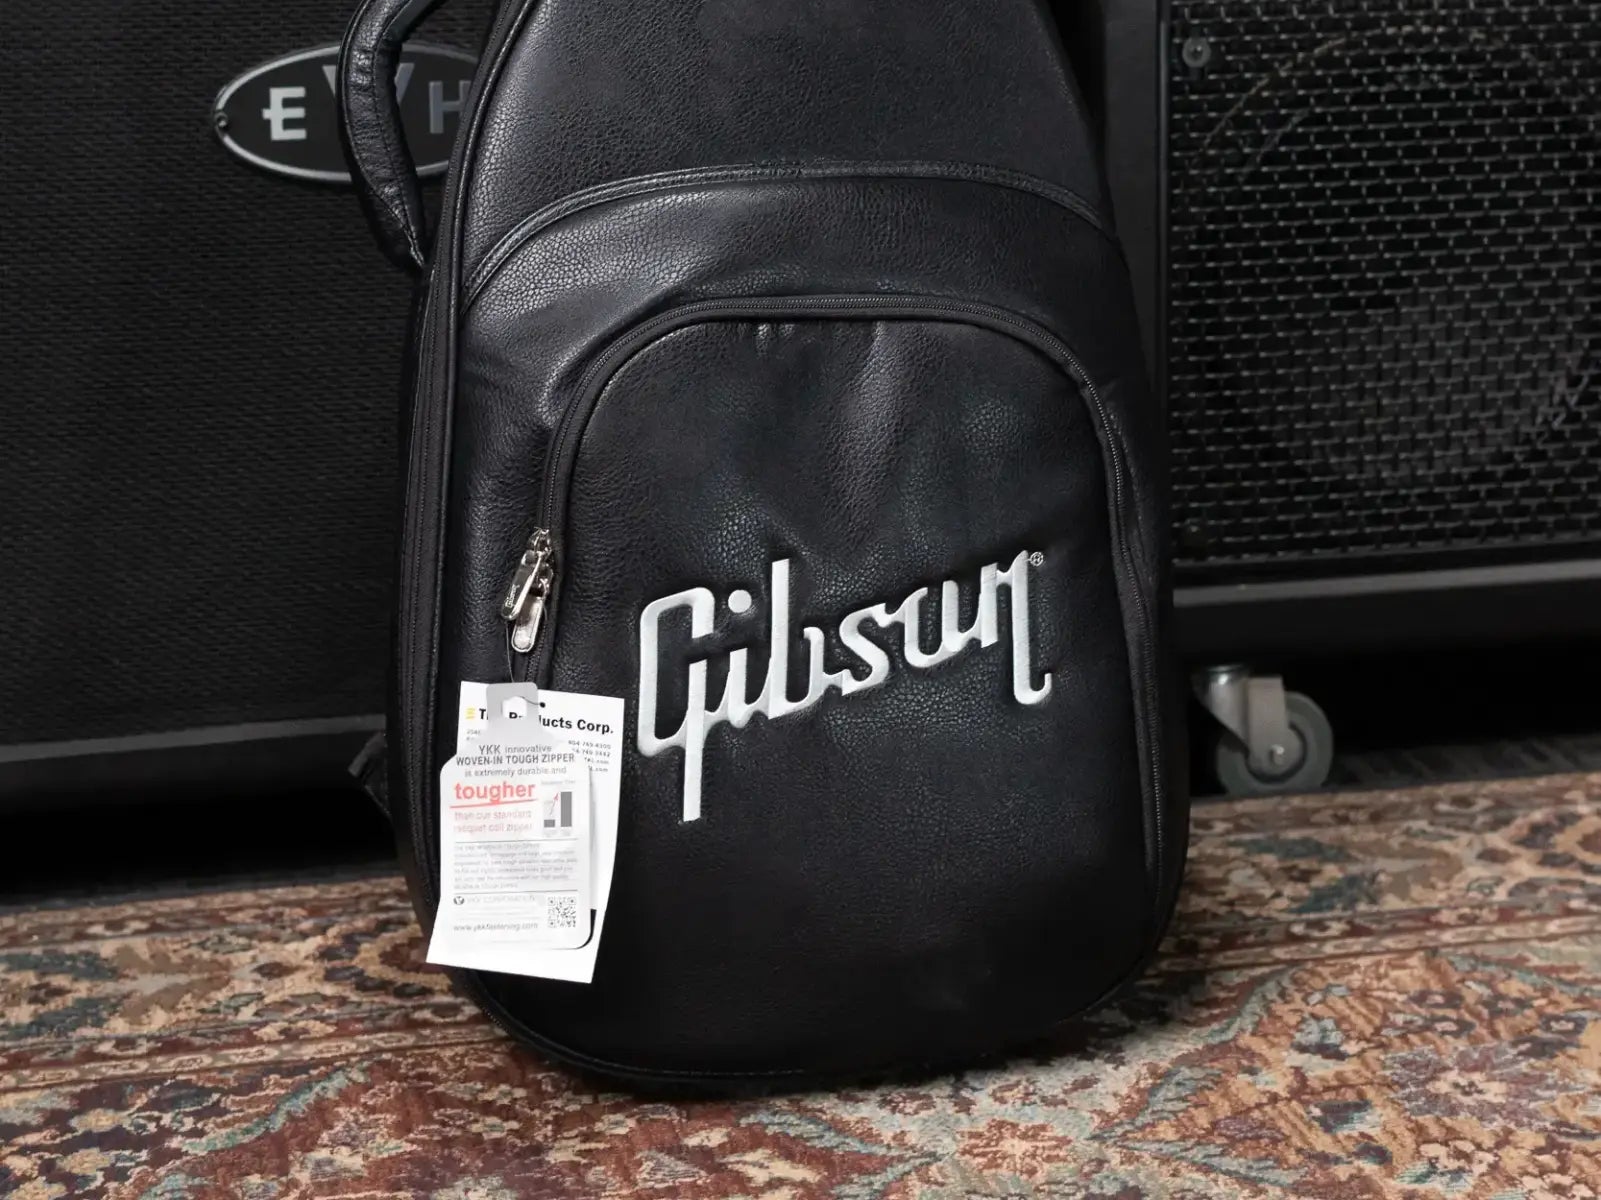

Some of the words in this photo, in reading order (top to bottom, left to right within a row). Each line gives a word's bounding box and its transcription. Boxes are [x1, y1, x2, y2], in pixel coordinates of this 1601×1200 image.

[638, 550, 1053, 822] Gibson
[577, 719, 614, 735] Corp.
[478, 744, 501, 755] YKK
[504, 744, 553, 754] innovative
[455, 754, 503, 766] WOVEN-IN
[505, 754, 539, 765] TOUGH
[541, 753, 575, 764] ZIPPER
[473, 767, 515, 778] extremely
[517, 766, 549, 776] durable
[551, 766, 567, 775] and
[454, 781, 536, 804] tougher
